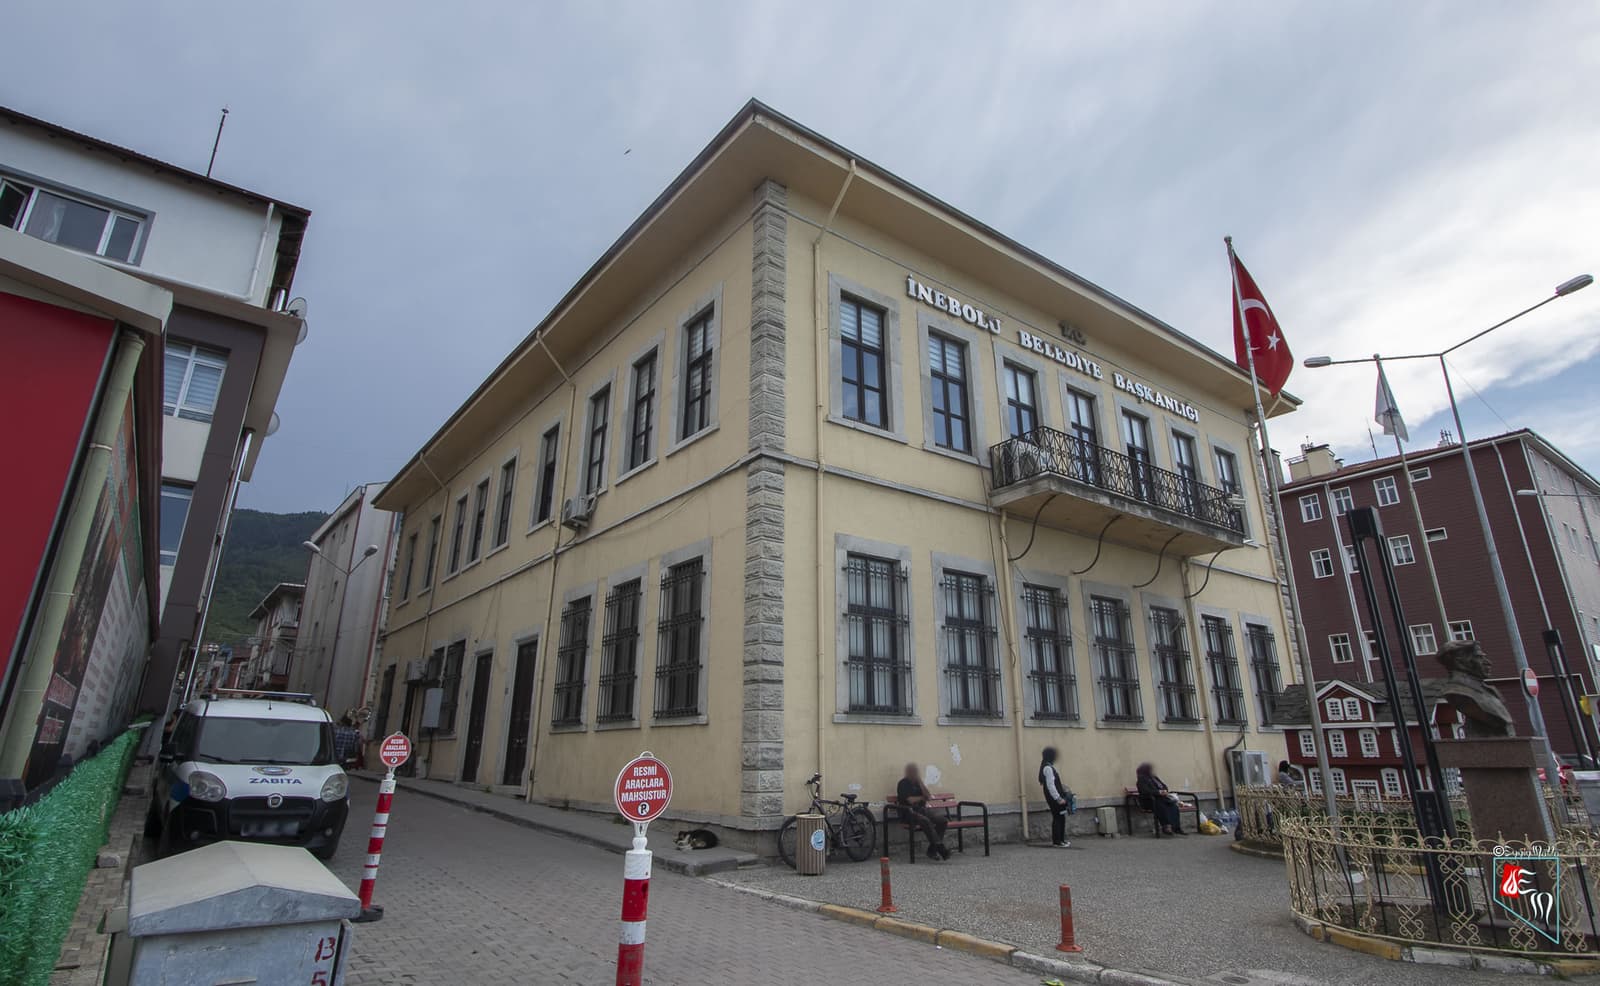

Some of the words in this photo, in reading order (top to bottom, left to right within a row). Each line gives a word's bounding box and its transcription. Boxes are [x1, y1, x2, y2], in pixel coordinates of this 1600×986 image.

[907, 274, 1001, 335] İNEBOLU
[1018, 329, 1104, 380] BELEDİYE
[1113, 371, 1199, 424] BAŞKANLIĞI
[633, 764, 657, 777] RESMİ
[625, 777, 664, 790] ARAÇLARA
[621, 789, 667, 802] MAHSUSTUR
[314, 936, 337, 963] 13
